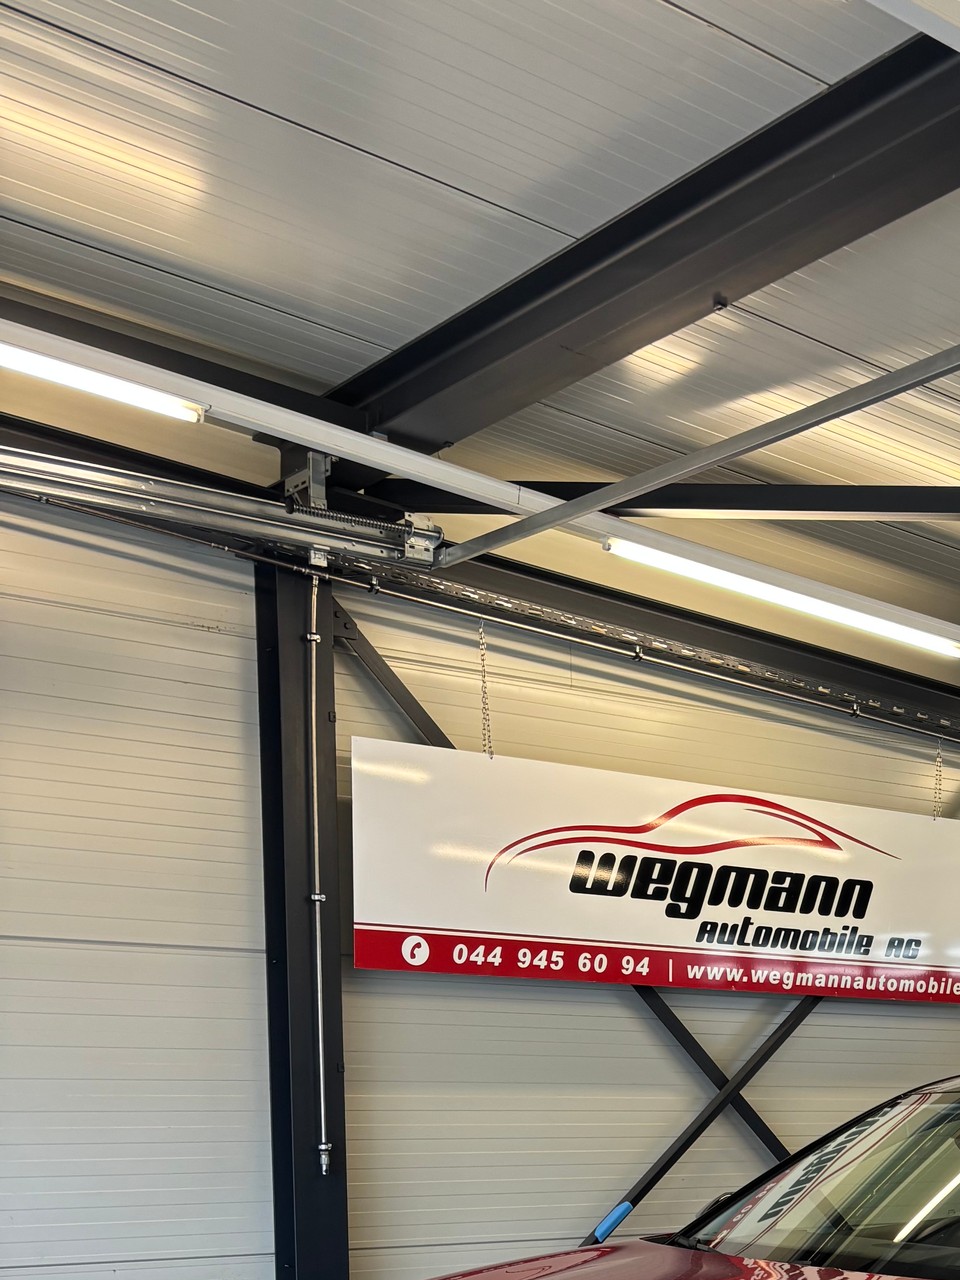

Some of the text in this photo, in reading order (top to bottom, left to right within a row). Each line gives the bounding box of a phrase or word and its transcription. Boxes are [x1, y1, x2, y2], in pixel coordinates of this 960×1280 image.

[568, 849, 874, 920] wegmann
[452, 943, 503, 967] 044
[517, 948, 564, 971] 945
[577, 952, 608, 973] 60
[621, 955, 650, 976] 94
[885, 936, 922, 960] AG
